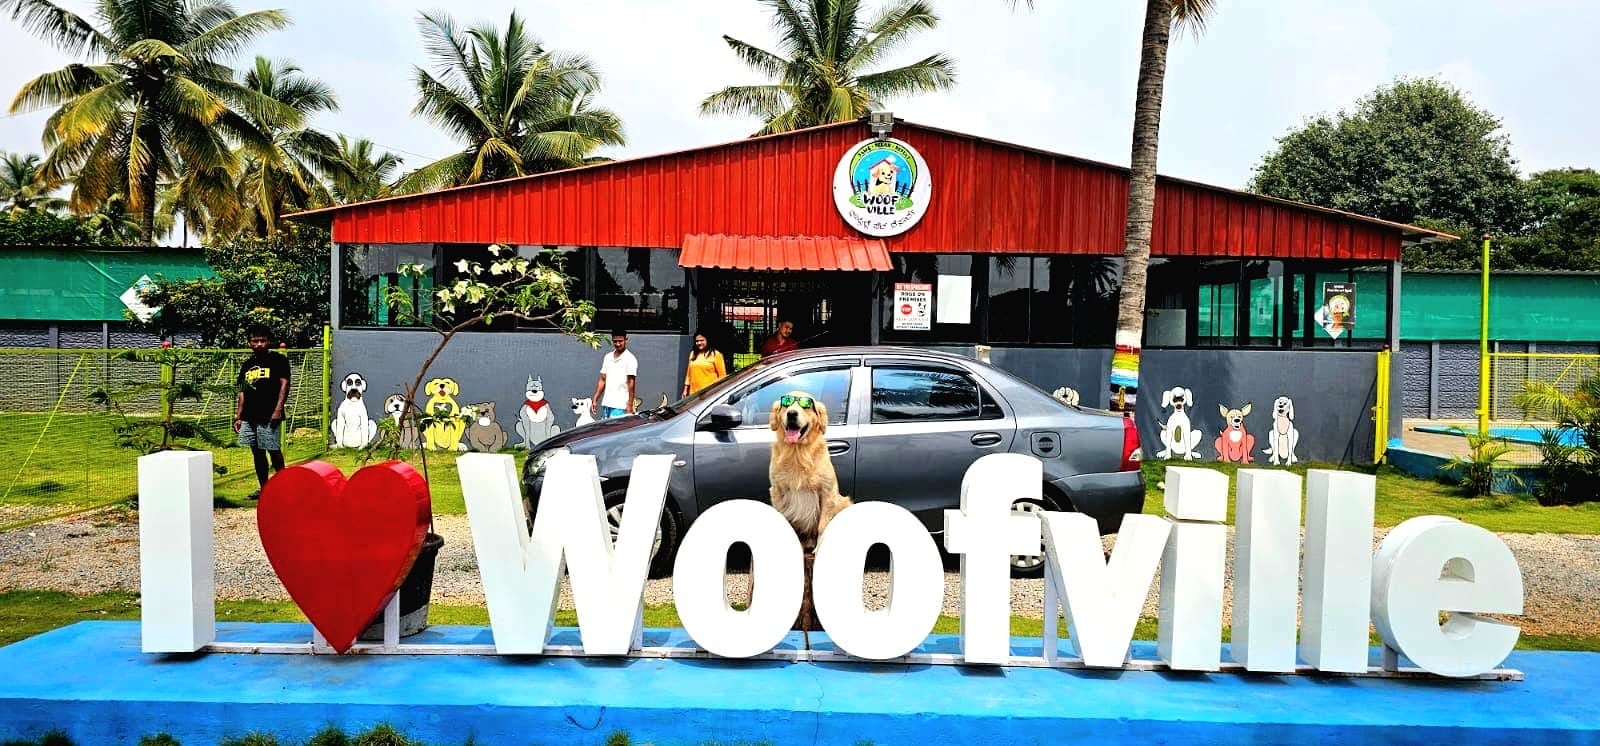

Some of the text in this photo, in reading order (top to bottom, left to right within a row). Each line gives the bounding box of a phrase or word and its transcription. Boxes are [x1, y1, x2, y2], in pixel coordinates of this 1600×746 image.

[863, 194, 899, 205] WOOF
[867, 206, 895, 215] VILLE
[138, 451, 1524, 677] I Woofville
